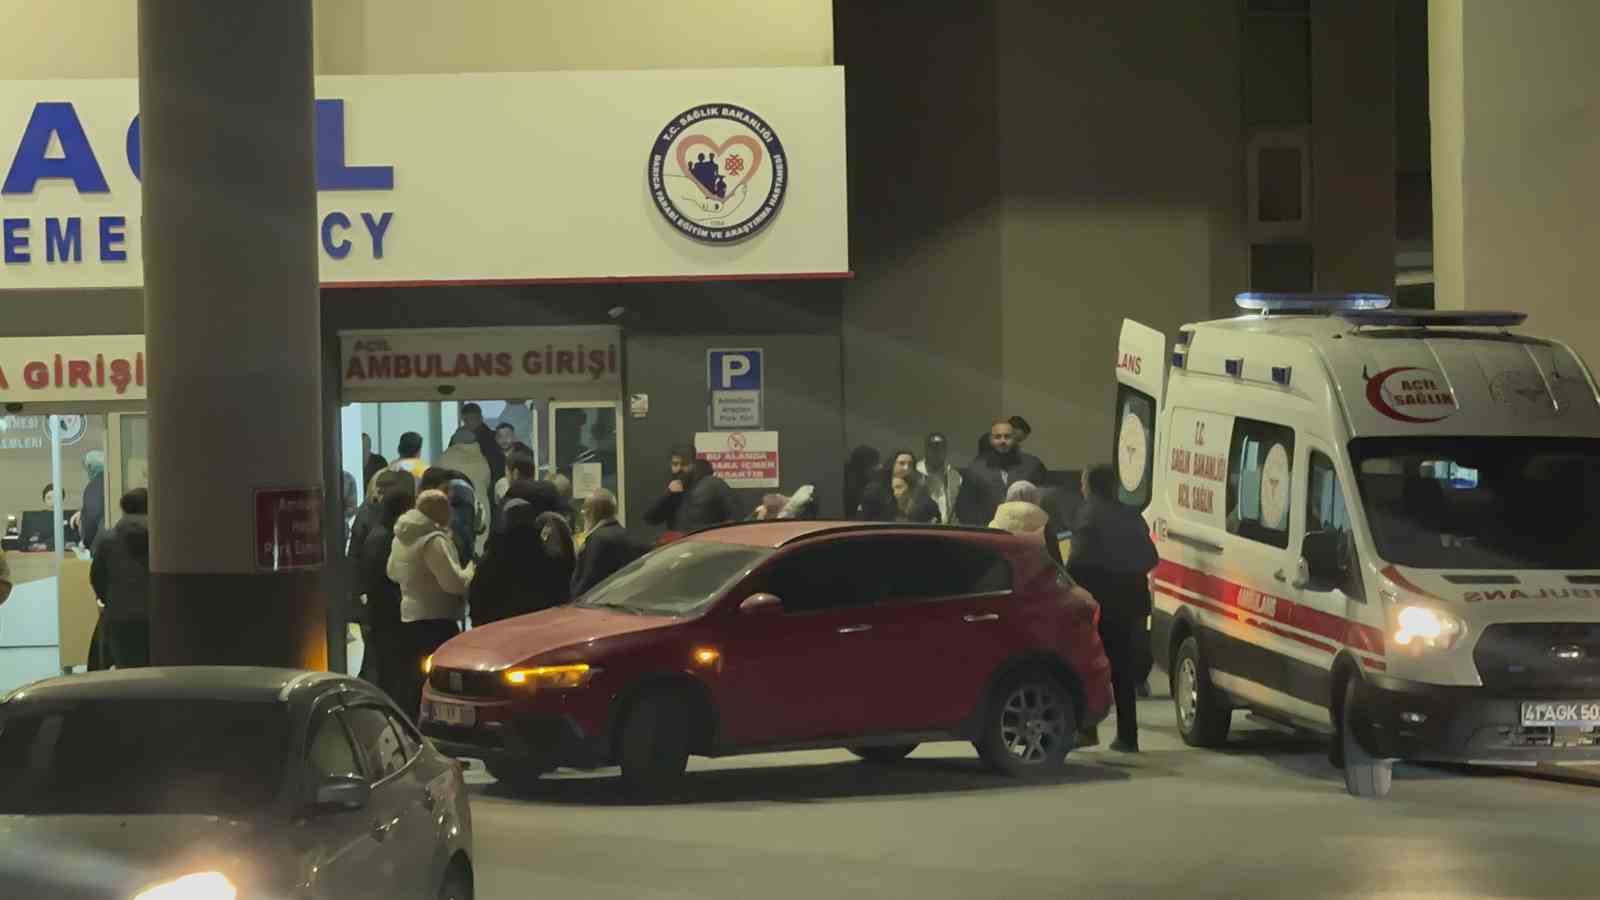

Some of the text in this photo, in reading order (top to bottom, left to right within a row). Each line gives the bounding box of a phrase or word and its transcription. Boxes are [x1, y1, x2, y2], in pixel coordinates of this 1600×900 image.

[710, 231, 723, 239] VE
[23, 351, 145, 394] GİRİŞİ
[345, 344, 616, 380] AMBULANS GİRİŞİ
[722, 354, 750, 388] P
[1525, 704, 1600, 721] 41 AGK 50
